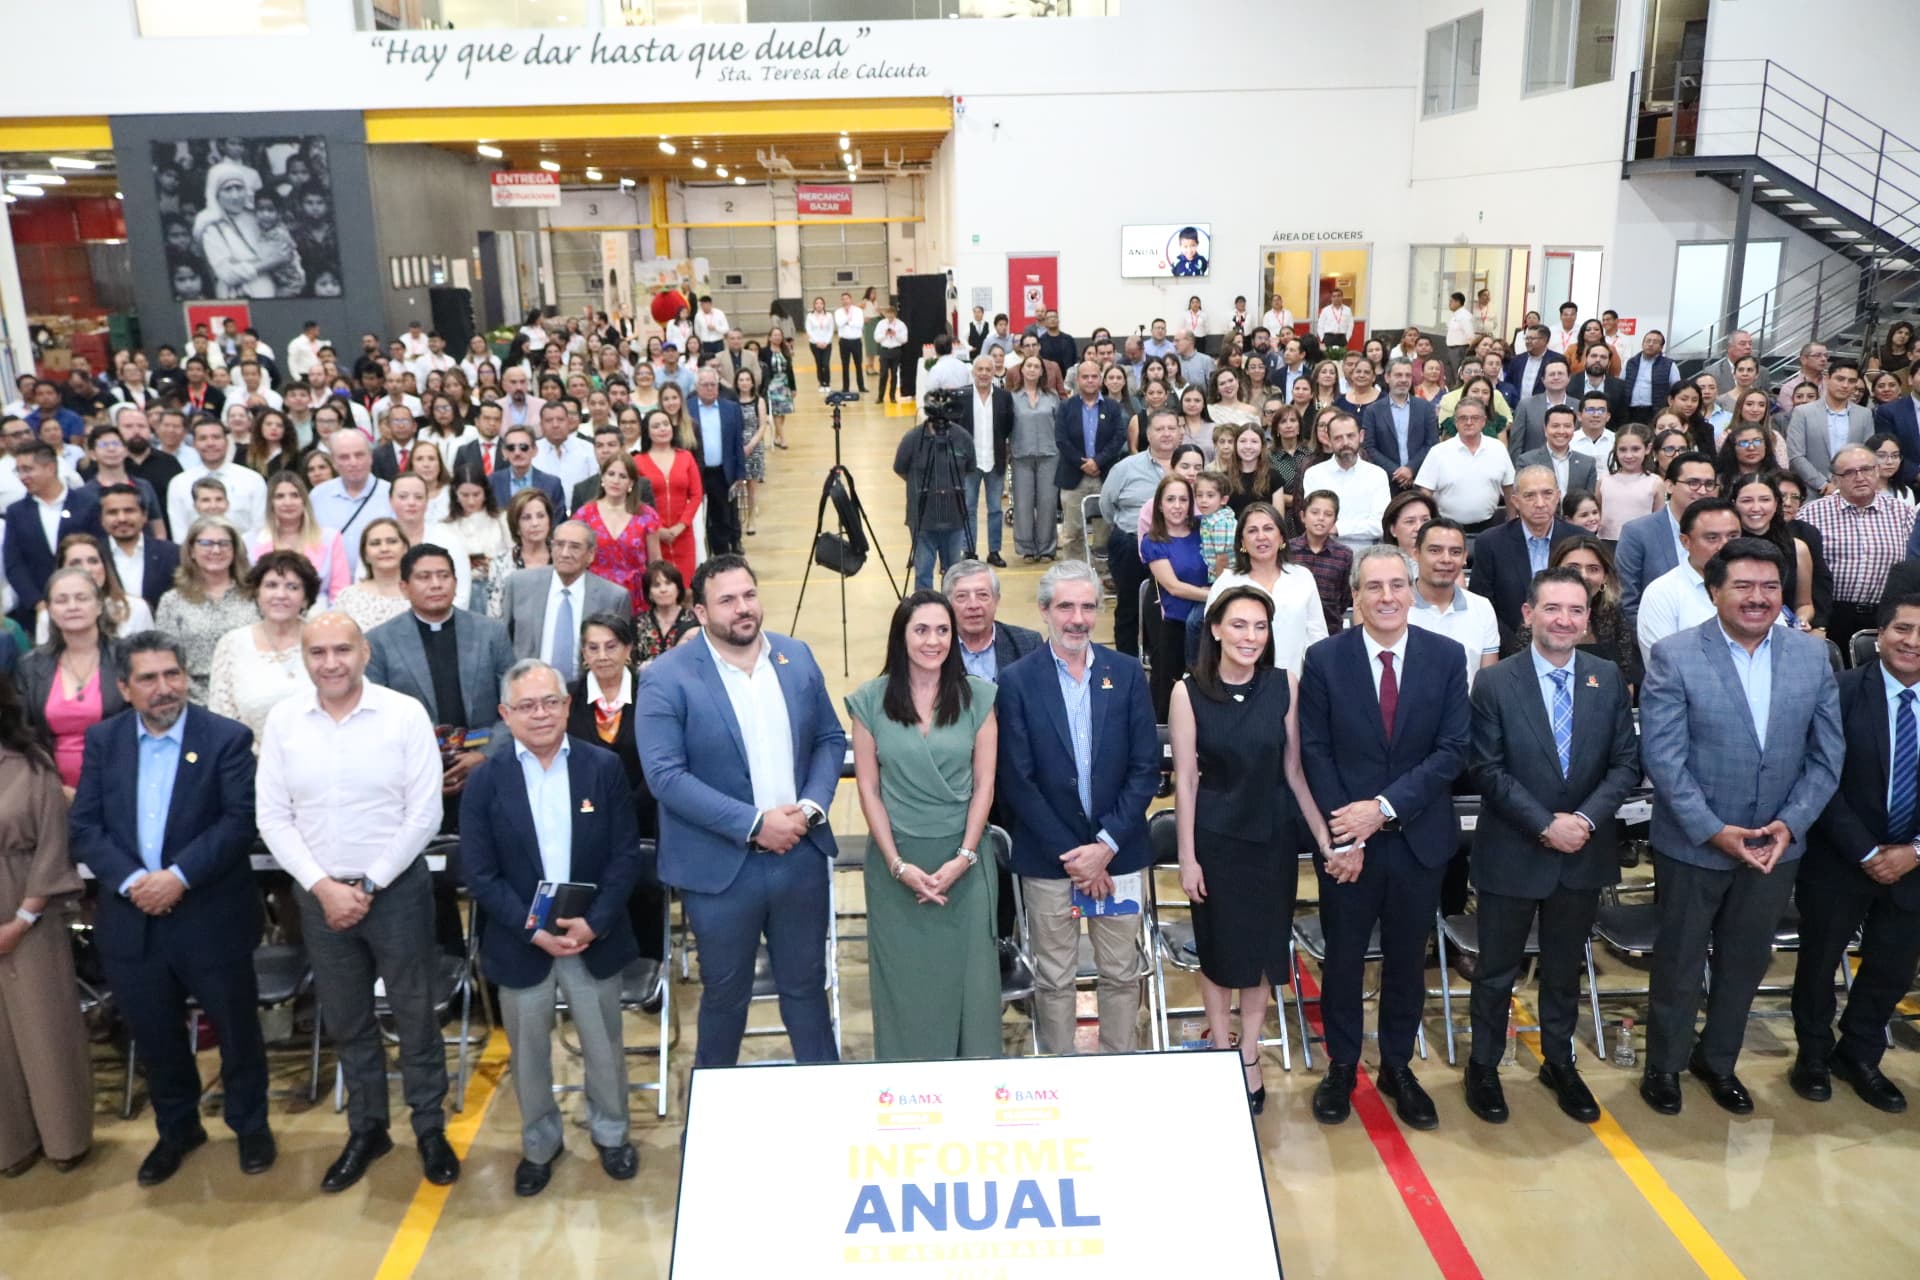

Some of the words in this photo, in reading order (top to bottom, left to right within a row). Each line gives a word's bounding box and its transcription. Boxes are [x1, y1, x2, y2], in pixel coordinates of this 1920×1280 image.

[457, 42, 519, 79] que
[524, 33, 581, 65] dar
[590, 32, 683, 64] hasta
[688, 38, 750, 79] que
[717, 65, 751, 82] Sta.
[761, 64, 823, 81] Teresa
[827, 61, 849, 80] de
[855, 59, 930, 79] Calcuta
[495, 173, 554, 185] ENTREGA
[588, 203, 599, 216] 3
[724, 201, 735, 213] 2
[809, 202, 840, 211] BAZAR
[1272, 231, 1300, 241] ÁREA
[1302, 232, 1315, 241] DE
[1317, 231, 1363, 240] LOCKERS
[899, 1093, 943, 1106] BAMX
[1015, 1090, 1059, 1102] BAMX
[848, 1138, 1094, 1179] INFORME
[844, 1178, 1101, 1234] ANUAL
